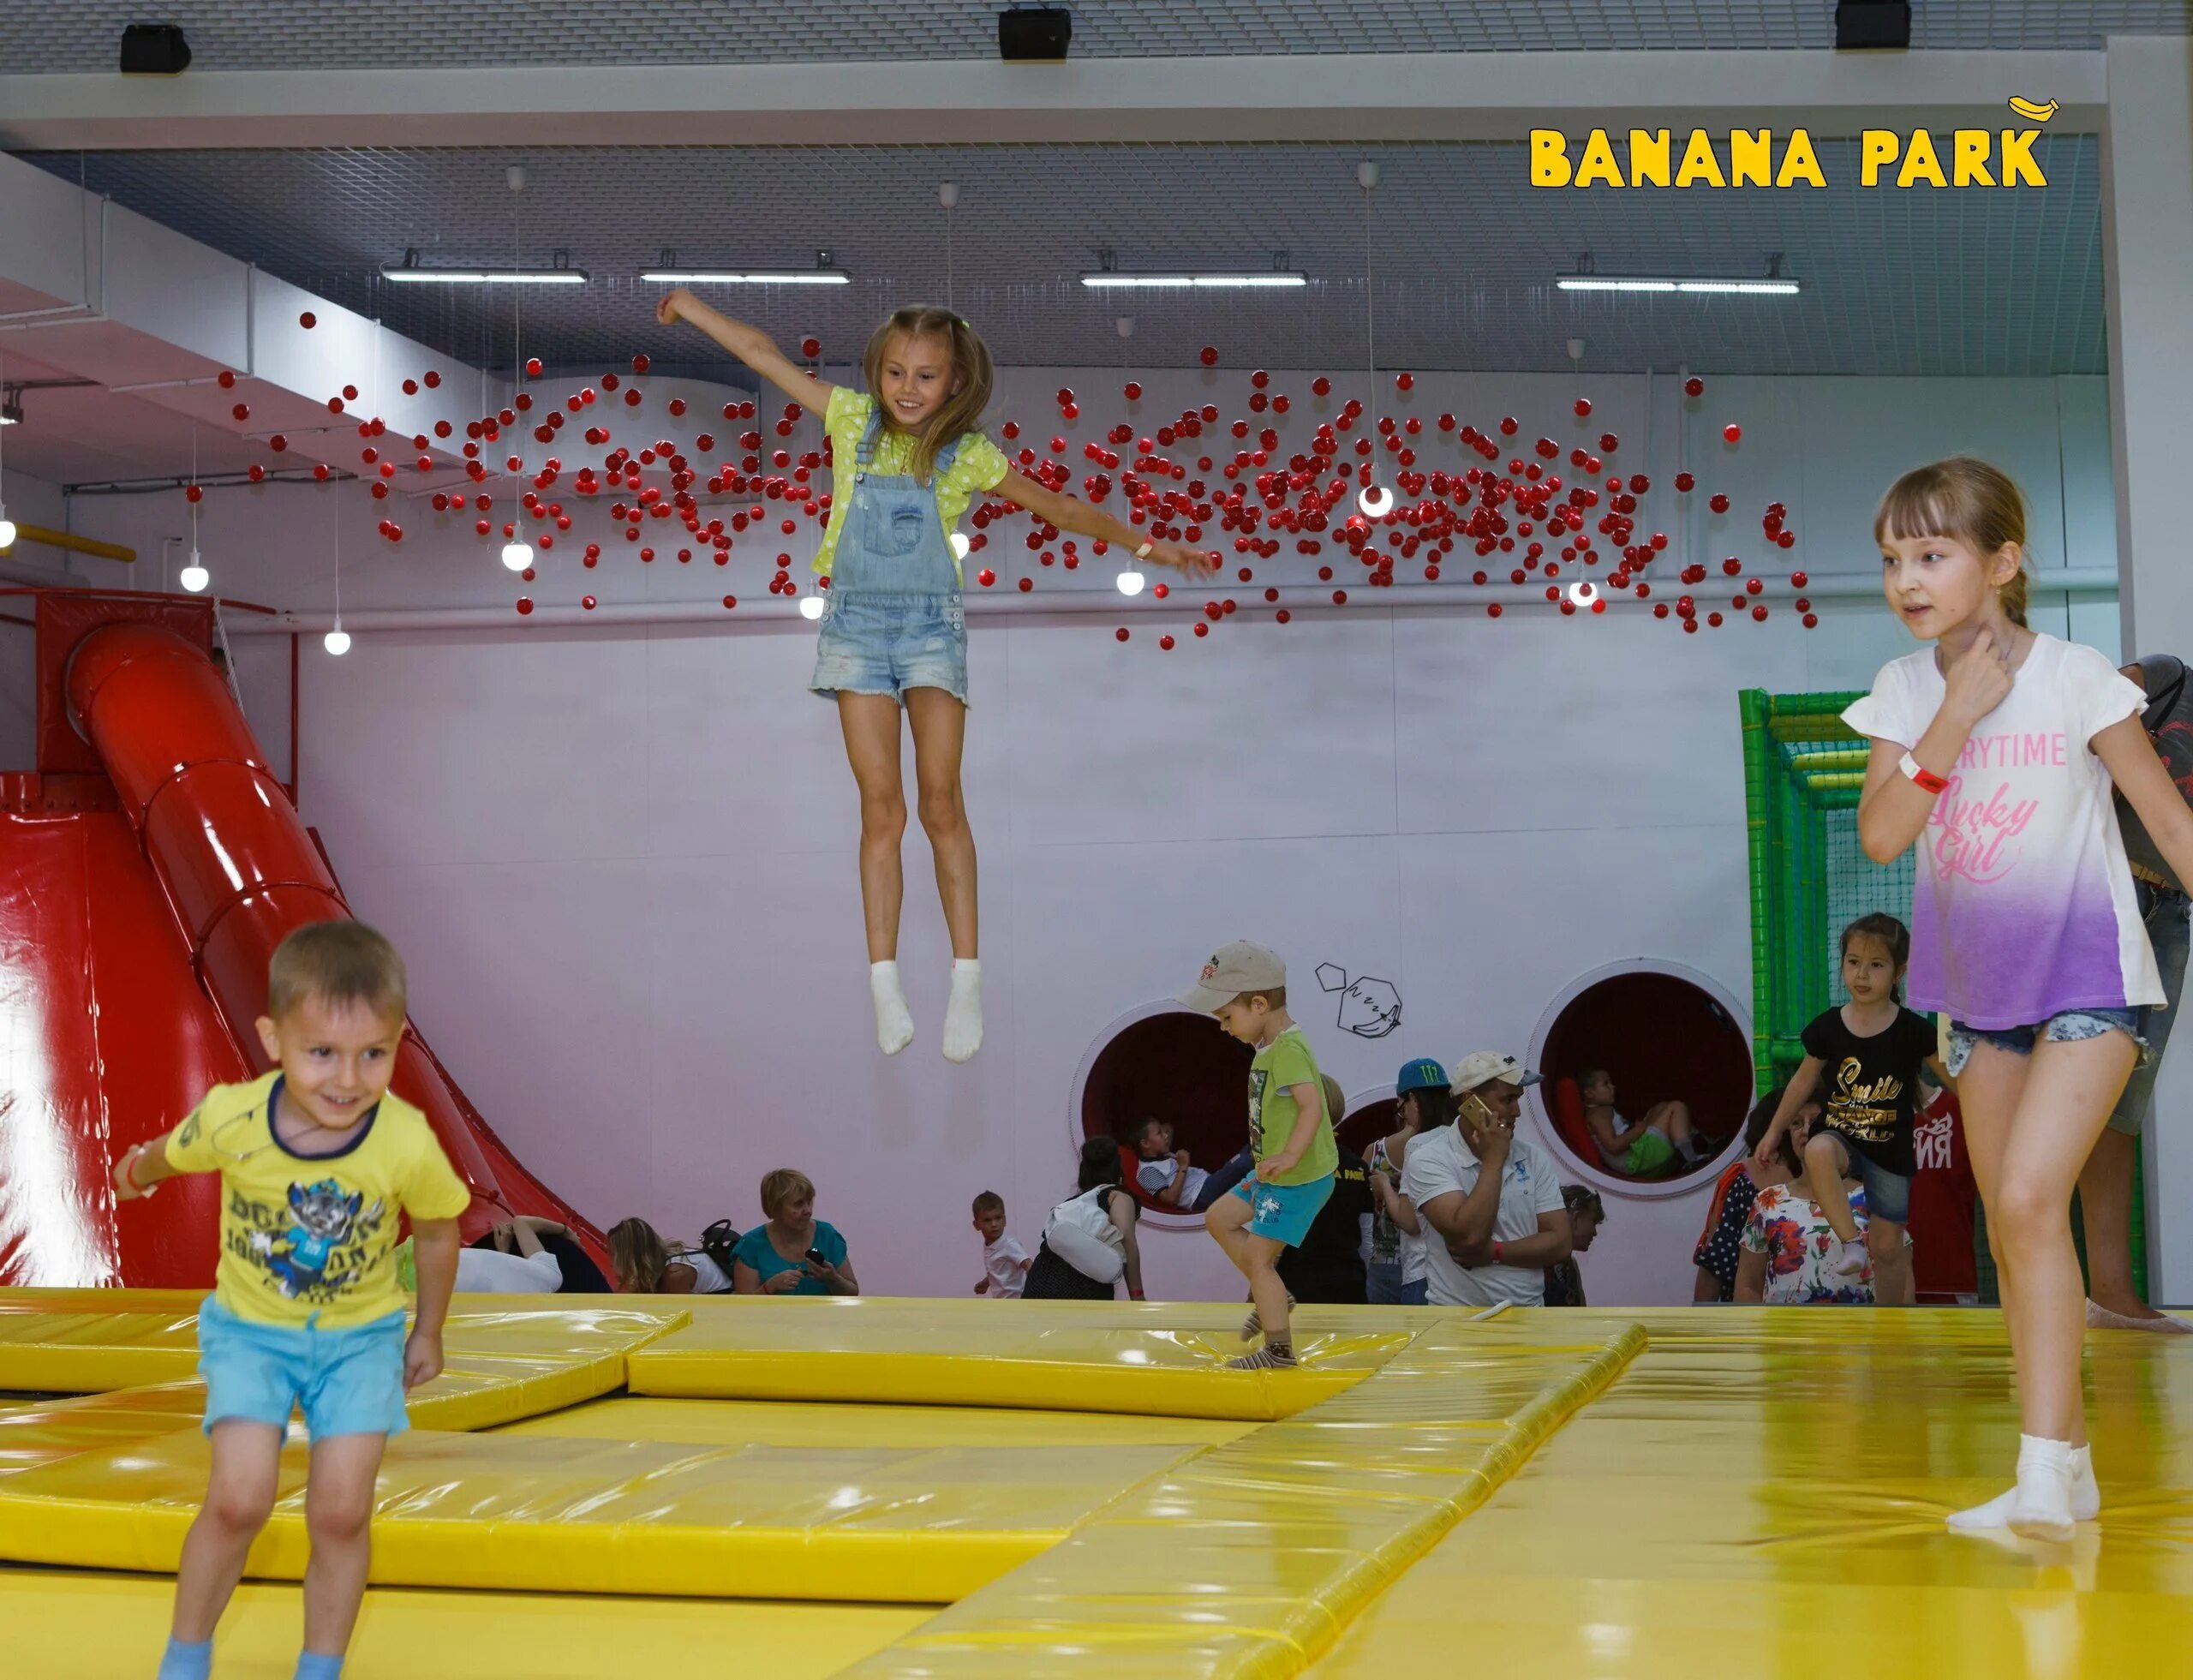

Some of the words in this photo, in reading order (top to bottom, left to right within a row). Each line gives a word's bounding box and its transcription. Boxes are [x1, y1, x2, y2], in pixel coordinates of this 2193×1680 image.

[1915, 733, 2067, 769] RYTIME
[1928, 775, 2040, 835] Lucky
[1934, 826, 2017, 884] Girl
[1831, 1056, 1903, 1105] Smile
